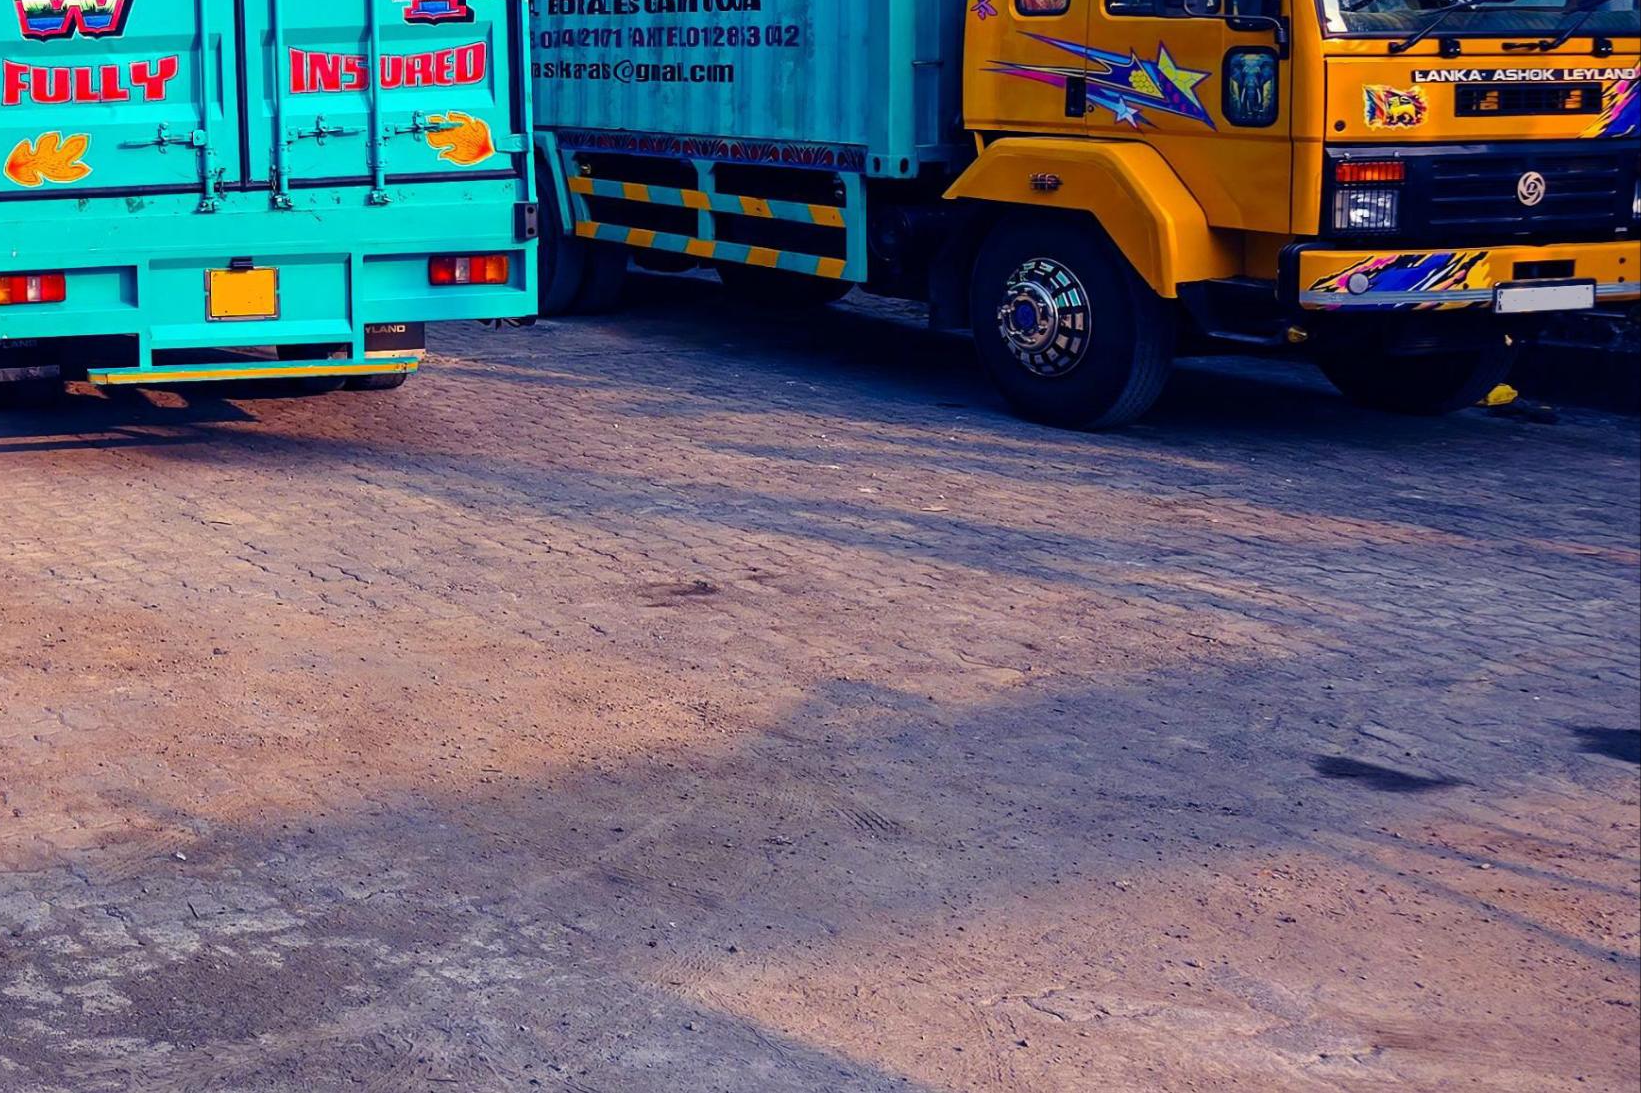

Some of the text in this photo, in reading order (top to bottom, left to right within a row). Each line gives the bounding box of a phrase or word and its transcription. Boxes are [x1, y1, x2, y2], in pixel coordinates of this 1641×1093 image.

[1, 54, 179, 106] FULLY
[288, 40, 487, 95] INSURED
[1492, 68, 1555, 81] ASHOK
[1563, 67, 1637, 80] LEYLAND
